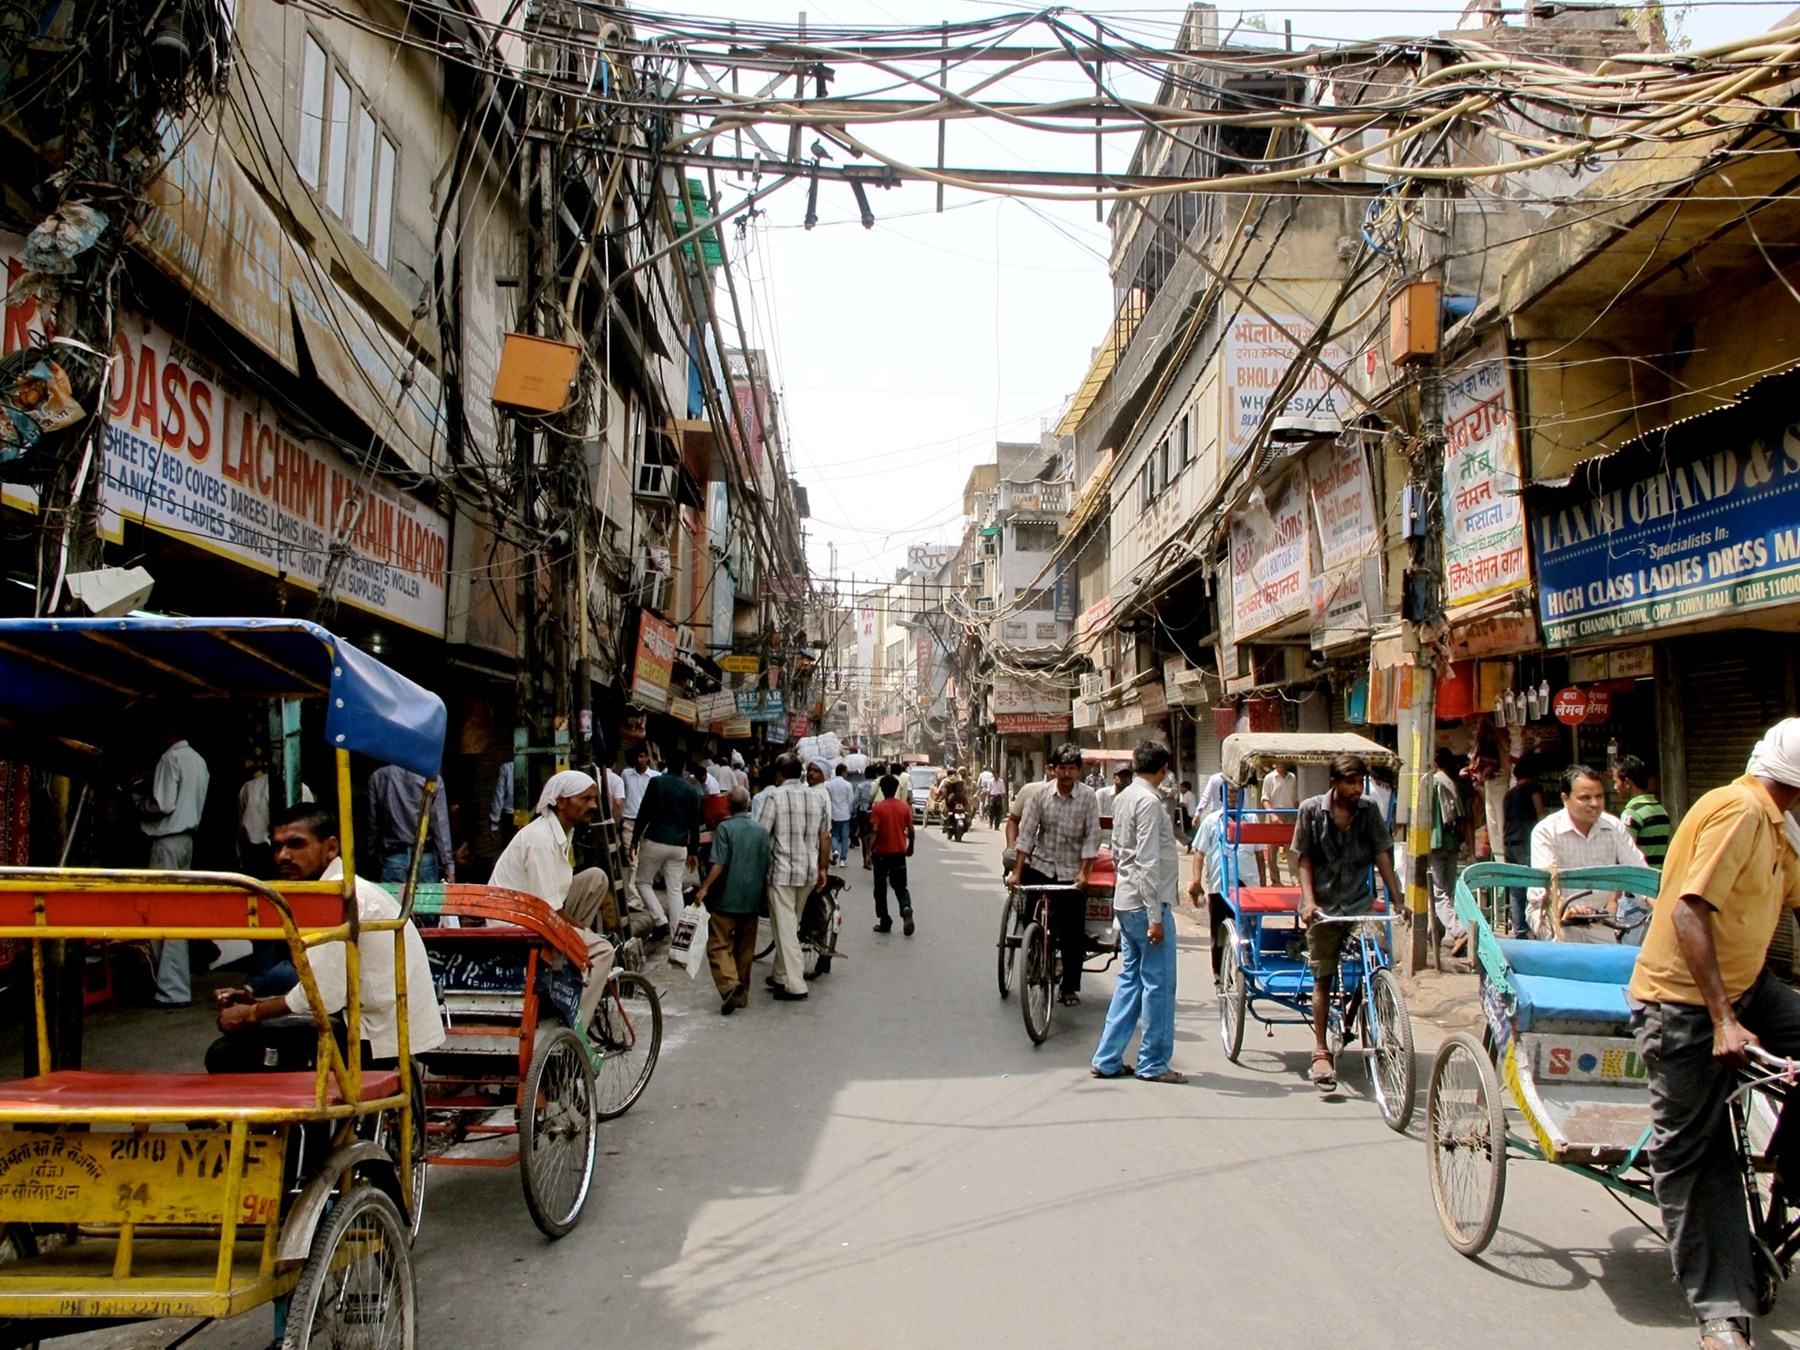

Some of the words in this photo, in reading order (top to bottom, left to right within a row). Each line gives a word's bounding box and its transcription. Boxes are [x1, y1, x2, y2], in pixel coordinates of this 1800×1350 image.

[1237, 366, 1279, 390] BHOLA
[1239, 394, 1336, 413] WHESALE
[161, 452, 183, 486] BED
[221, 397, 327, 528] LACHHMI
[396, 511, 446, 589] KAPOOR
[1456, 481, 1492, 513] लेमन
[1542, 488, 1625, 555] LAXMI
[1629, 450, 1738, 526] CHAND
[1743, 439, 1775, 489] &
[1464, 503, 1504, 533] मसाला
[182, 494, 226, 539] LADIES
[228, 517, 274, 560] SHAWLS
[348, 571, 387, 608] SUPPLIERS
[1649, 530, 1713, 561] Specialists
[1714, 525, 1730, 544] In:
[1474, 554, 1499, 584] लेमन
[1501, 546, 1524, 576] वाला
[1547, 584, 1585, 618] HIGH
[1588, 572, 1635, 607] CLASS
[1638, 555, 1703, 596] LADIES
[1707, 537, 1768, 580] DRESS
[1675, 595, 1703, 617] TOWN
[737, 690, 781, 703] MEAR
[1555, 700, 1585, 716] लेमन
